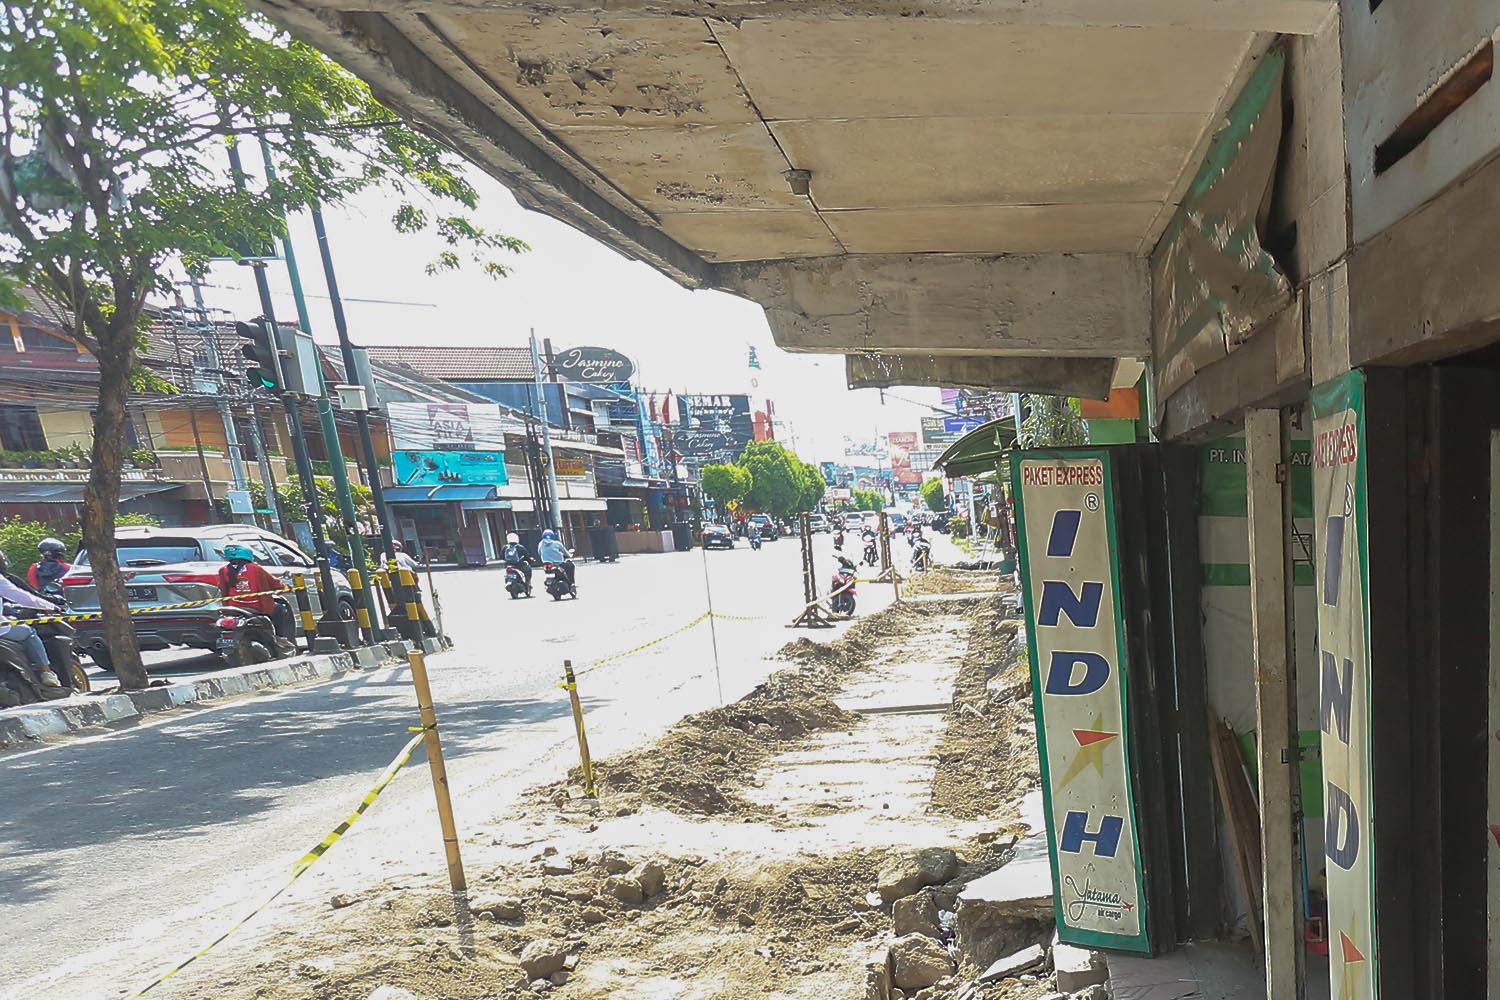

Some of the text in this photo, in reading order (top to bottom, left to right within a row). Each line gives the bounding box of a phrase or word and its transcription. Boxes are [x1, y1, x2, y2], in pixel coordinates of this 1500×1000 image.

[563, 349, 623, 368] Jasmine
[1210, 449, 1228, 463] PT.
[1024, 465, 1102, 485] PAKET EXPRESS
[1065, 876, 1121, 921] Yatama
